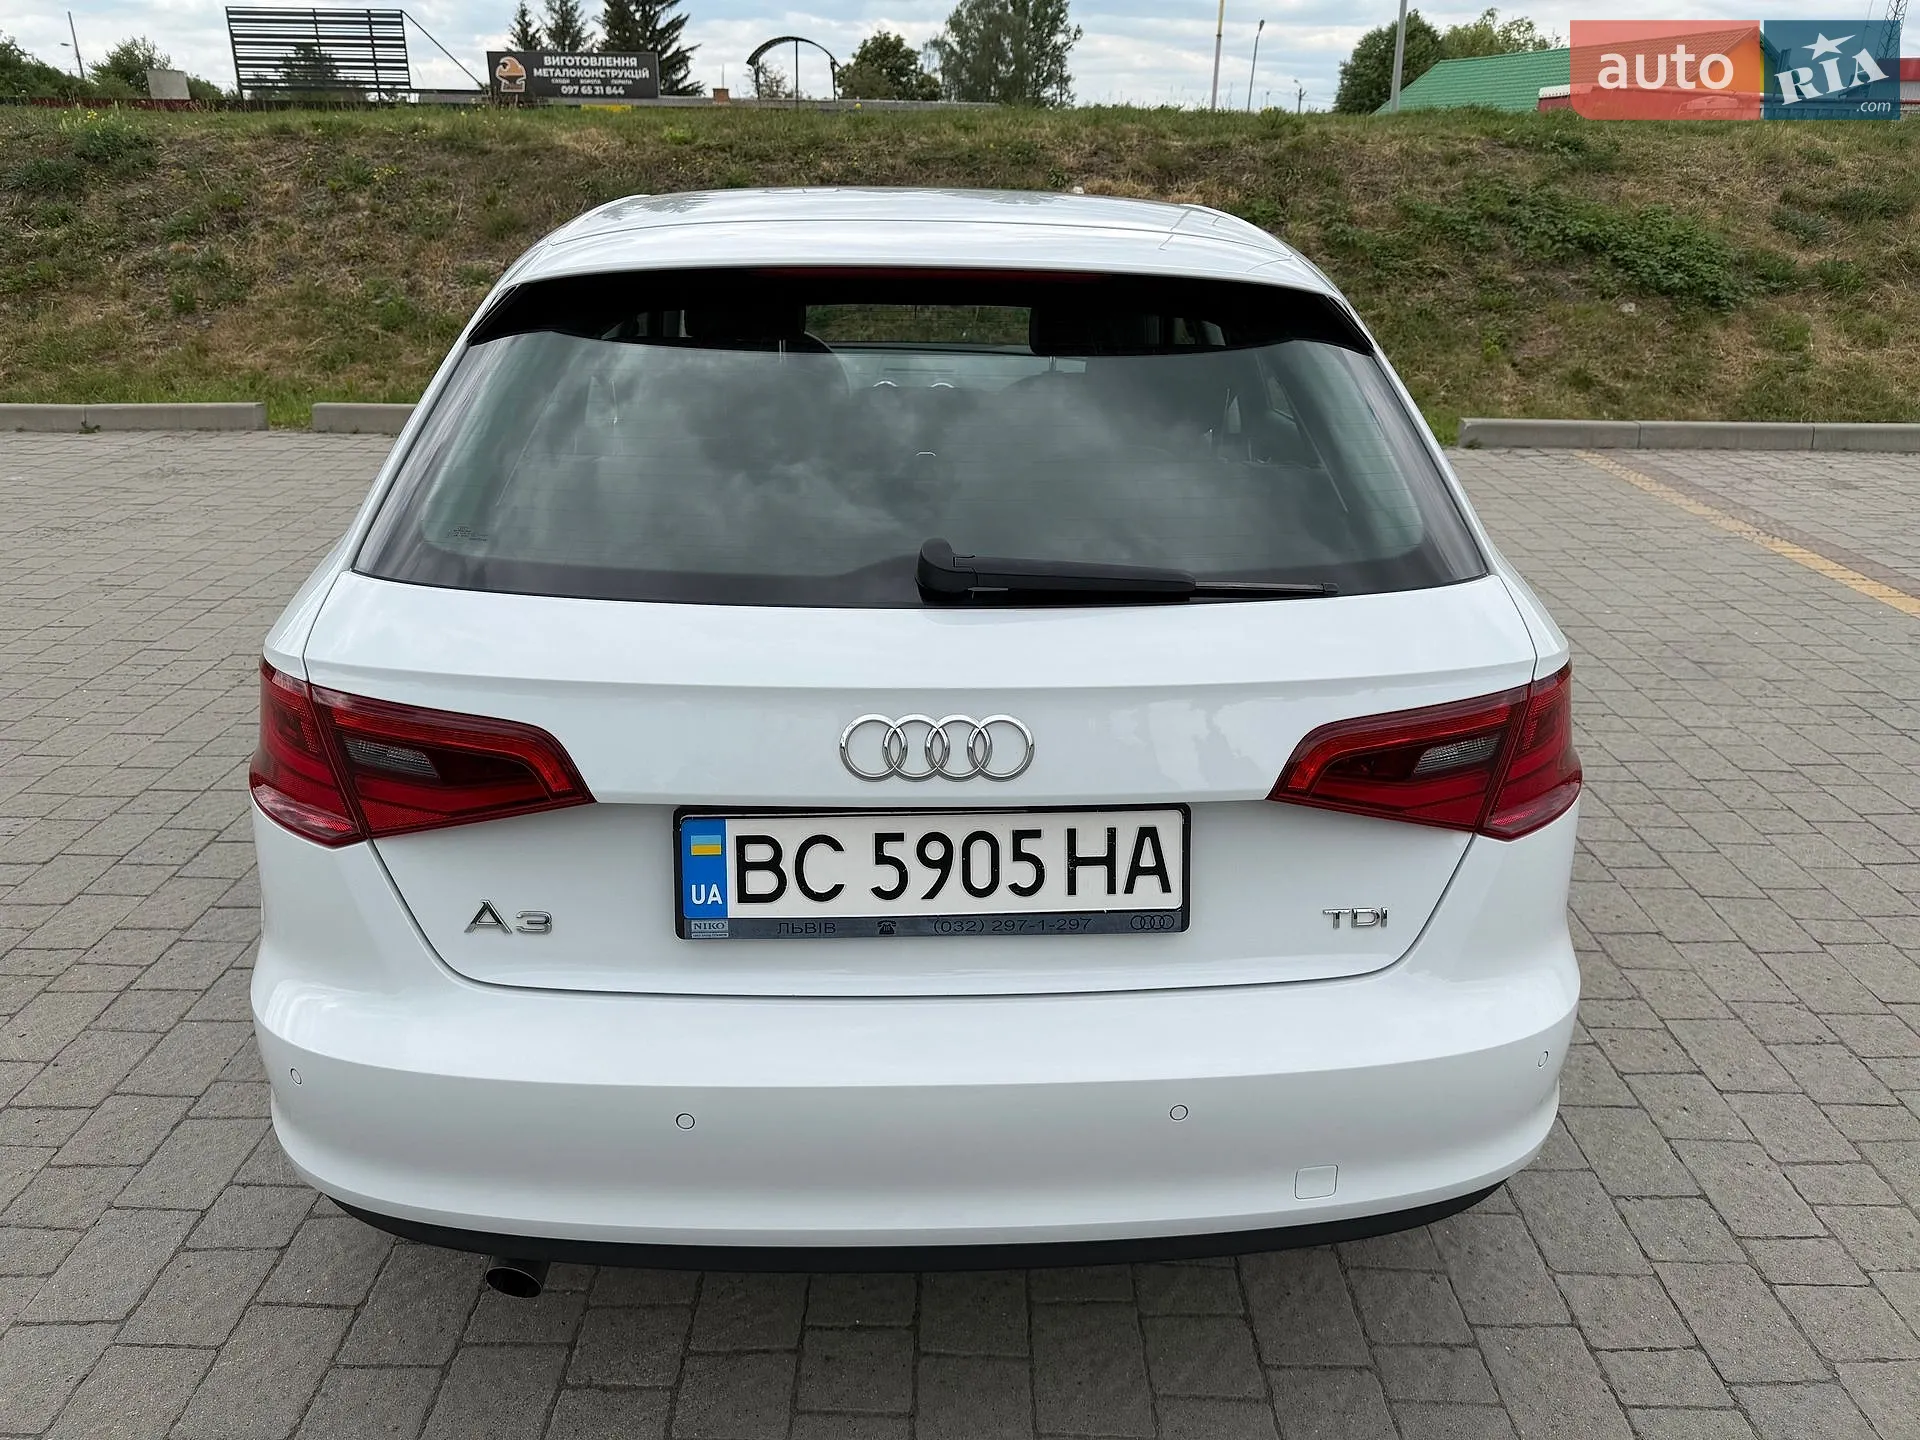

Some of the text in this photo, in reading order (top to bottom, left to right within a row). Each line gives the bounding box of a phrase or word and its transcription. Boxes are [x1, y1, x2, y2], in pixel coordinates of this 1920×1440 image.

[543, 56, 638, 67] ВИГОТОВЛЕННЯ
[533, 68, 650, 79] МЕТАЛОКОНСТРУКЦІЙ
[560, 85, 625, 95] 097 65 31 844
[736, 826, 1173, 904] BC 5905 HA
[691, 883, 723, 905] UA
[463, 899, 553, 934] A3
[1322, 907, 1388, 929] TDI
[693, 922, 725, 930] NIKO
[777, 922, 837, 934] ЛЬВІВ
[933, 918, 1092, 934] (032) 297-1-297
